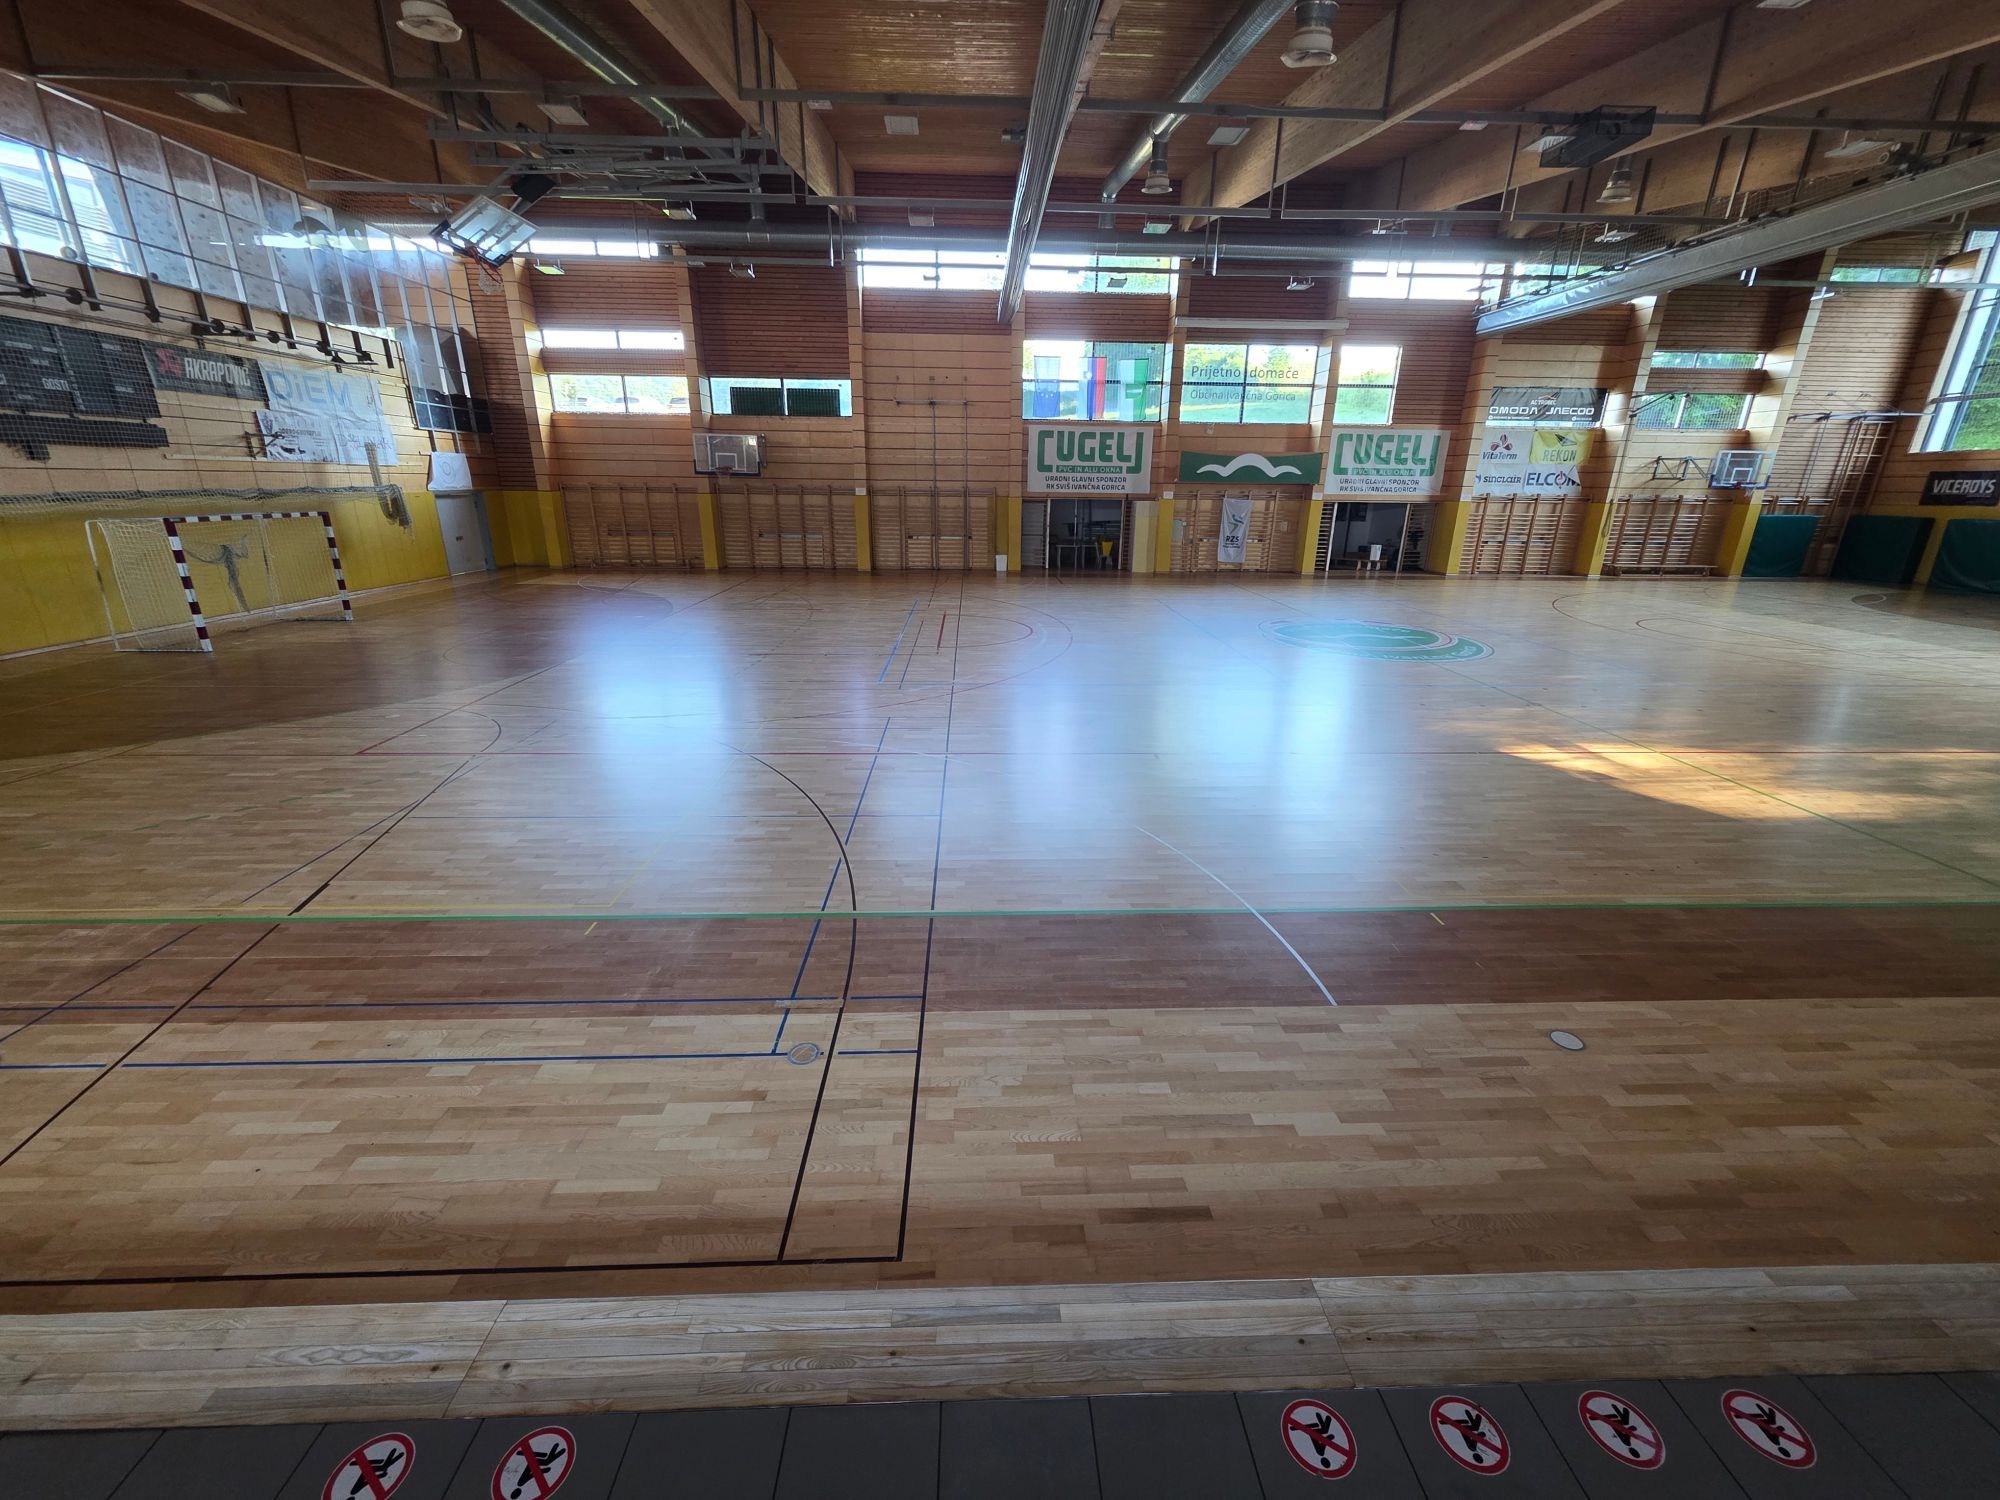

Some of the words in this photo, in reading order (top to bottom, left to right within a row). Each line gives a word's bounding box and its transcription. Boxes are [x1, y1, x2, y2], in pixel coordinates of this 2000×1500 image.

[1191, 366, 1240, 379] Prijetno
[1249, 366, 1299, 379] domače
[1265, 391, 1296, 401] Gorica
[1489, 406, 1538, 415] OMODA
[1545, 407, 1594, 416] JAECOO
[1037, 430, 1144, 474] CUGELJ
[1333, 433, 1441, 476] CUGELJ
[1482, 452, 1518, 460] VitaTerm
[1542, 450, 1577, 462] REKON
[1099, 466, 1121, 474] OKNA
[1071, 483, 1101, 491] IVANČNA
[1933, 480, 1997, 494] VICEROYS
[1226, 535, 1240, 543] RZS
